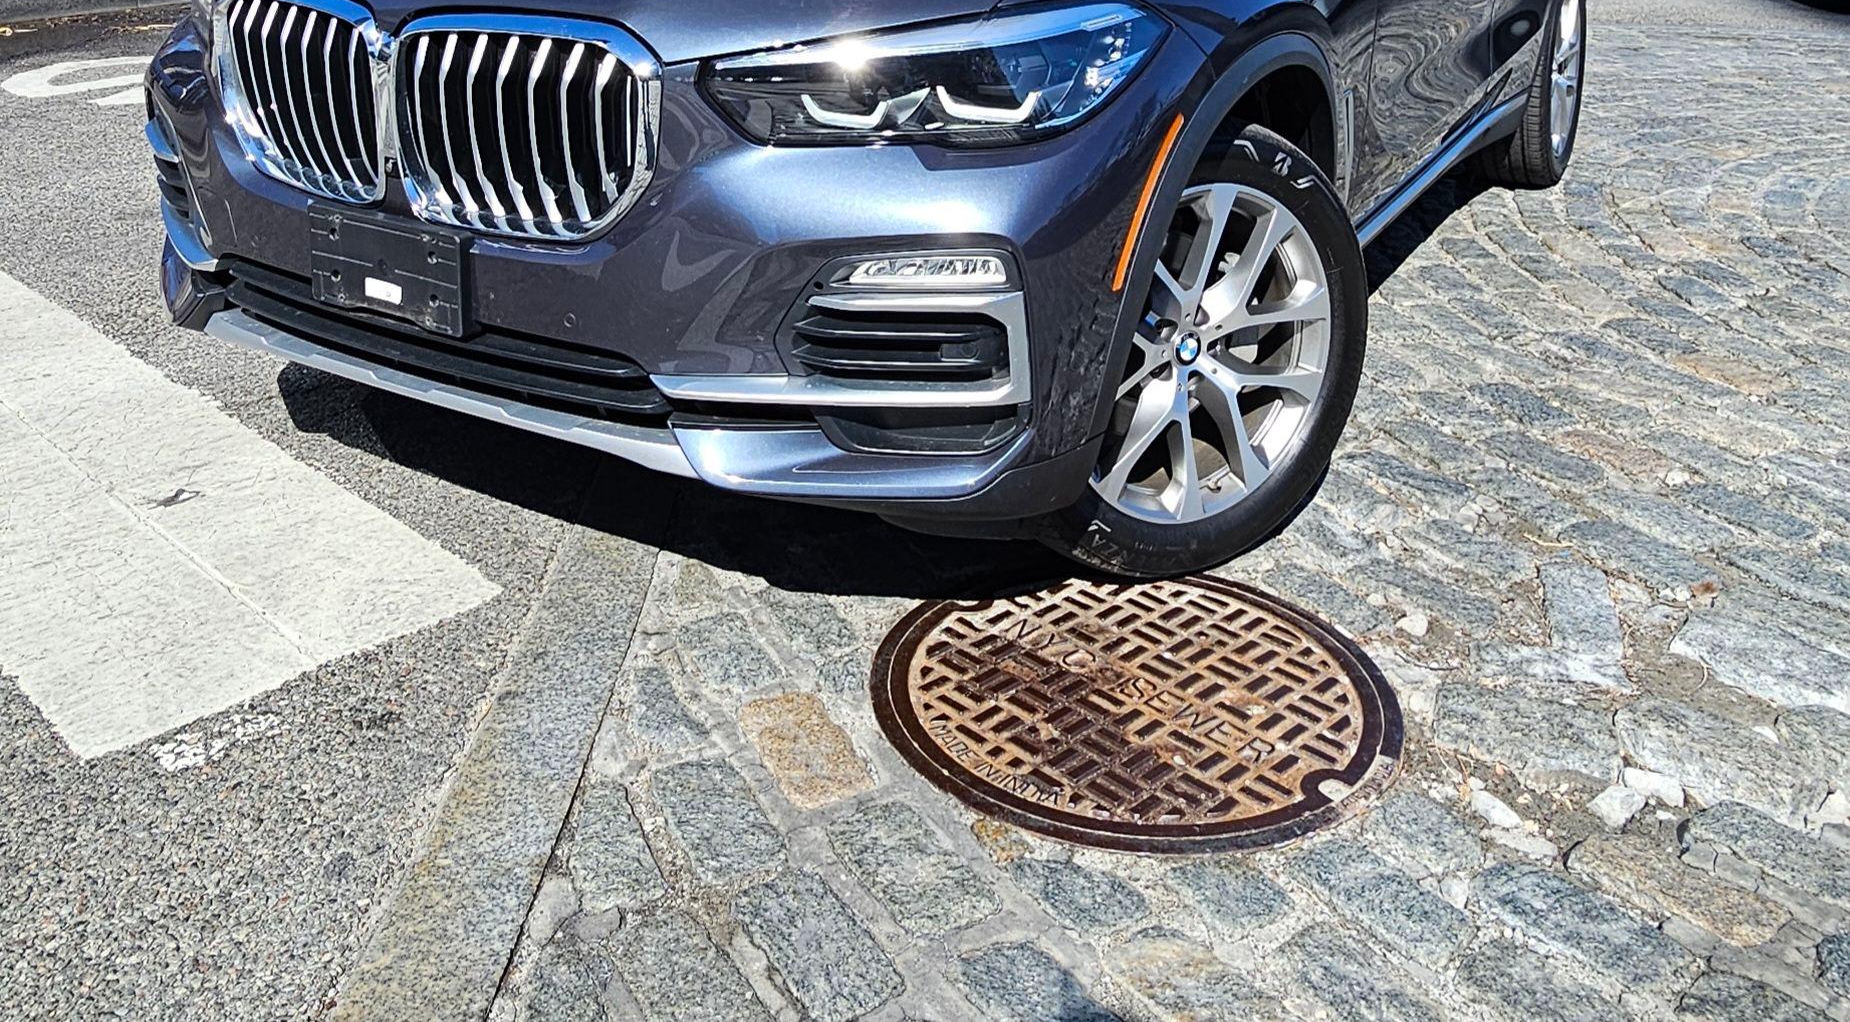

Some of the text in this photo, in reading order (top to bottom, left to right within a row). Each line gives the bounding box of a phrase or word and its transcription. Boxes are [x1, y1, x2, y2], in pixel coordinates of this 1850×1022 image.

[929, 720, 1058, 805] MADE IN INDIA
[1119, 677, 1275, 763] SEWER
